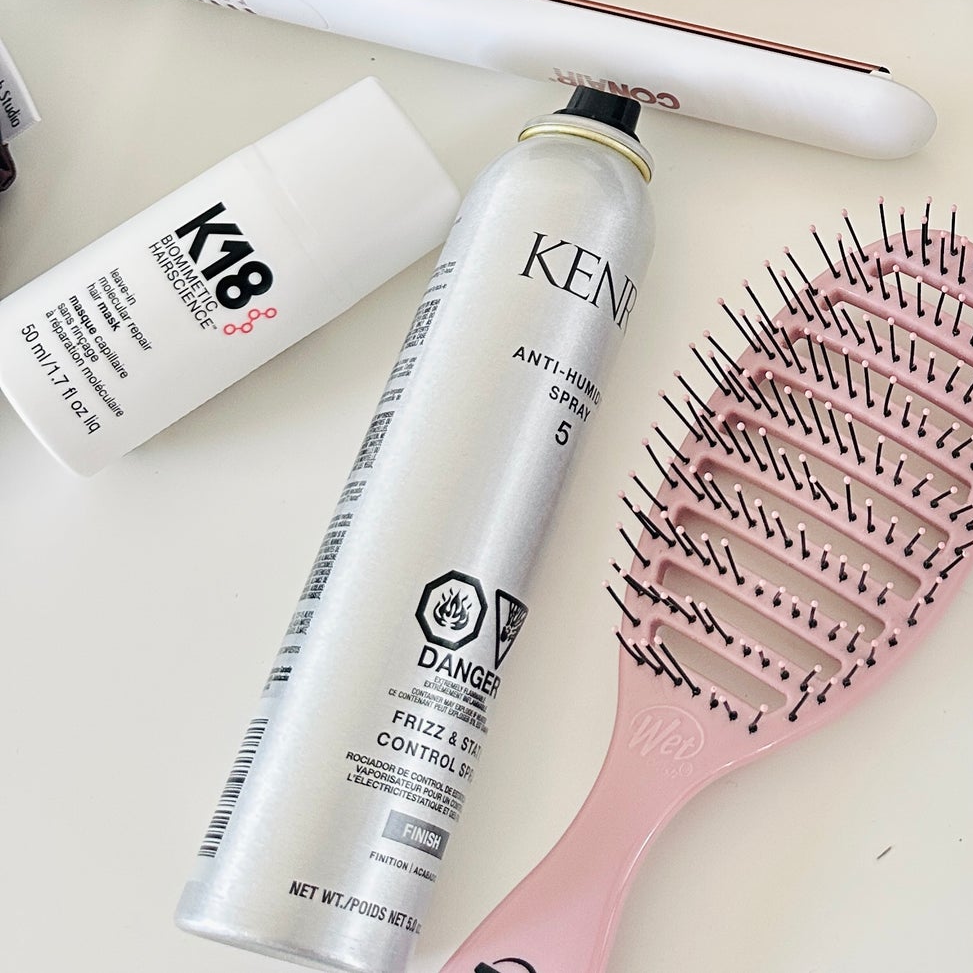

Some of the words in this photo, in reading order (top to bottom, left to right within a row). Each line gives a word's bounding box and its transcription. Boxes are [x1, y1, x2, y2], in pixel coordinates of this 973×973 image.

[0, 90, 21, 128] Studio
[160, 233, 219, 312] BIOMIMETIC
[174, 201, 274, 310] K18
[86, 282, 102, 303] hair
[96, 300, 121, 332] mask
[109, 266, 137, 306] leave-in
[45, 308, 57, 319] à
[57, 301, 75, 326] sans
[71, 324, 99, 364] rinçage
[68, 294, 98, 335] masque
[94, 334, 129, 379] capillaire
[98, 276, 131, 322] molecular
[127, 320, 153, 351] repair
[50, 317, 85, 368] réparation
[21, 323, 39, 344] 50
[61, 387, 79, 402] fl
[70, 398, 90, 419] oz
[83, 413, 101, 435] liq
[81, 364, 125, 418] moléculaire
[512, 346, 603, 407] ANTI-HUMID
[549, 385, 592, 423] SPRAY
[554, 420, 573, 446] 5
[417, 644, 502, 700] DANGER
[388, 687, 398, 698] CE
[398, 690, 434, 709] CONTENANT
[376, 731, 457, 773] CONTROL
[391, 710, 443, 741] FRIZZ
[448, 731, 459, 746] &
[628, 711, 700, 761] Wet
[345, 751, 396, 773] ROCIADOR
[397, 765, 410, 777] DE
[410, 770, 446, 794] CONTROL
[444, 784, 454, 795] DE
[355, 764, 423, 793] VAPORISATEUR
[423, 787, 444, 802] POUR
[369, 850, 409, 871] FINITION
[402, 823, 442, 851] FINISH
[289, 880, 319, 900] NET
[321, 888, 388, 921] WT./POIDS
[387, 911, 407, 929] NET
